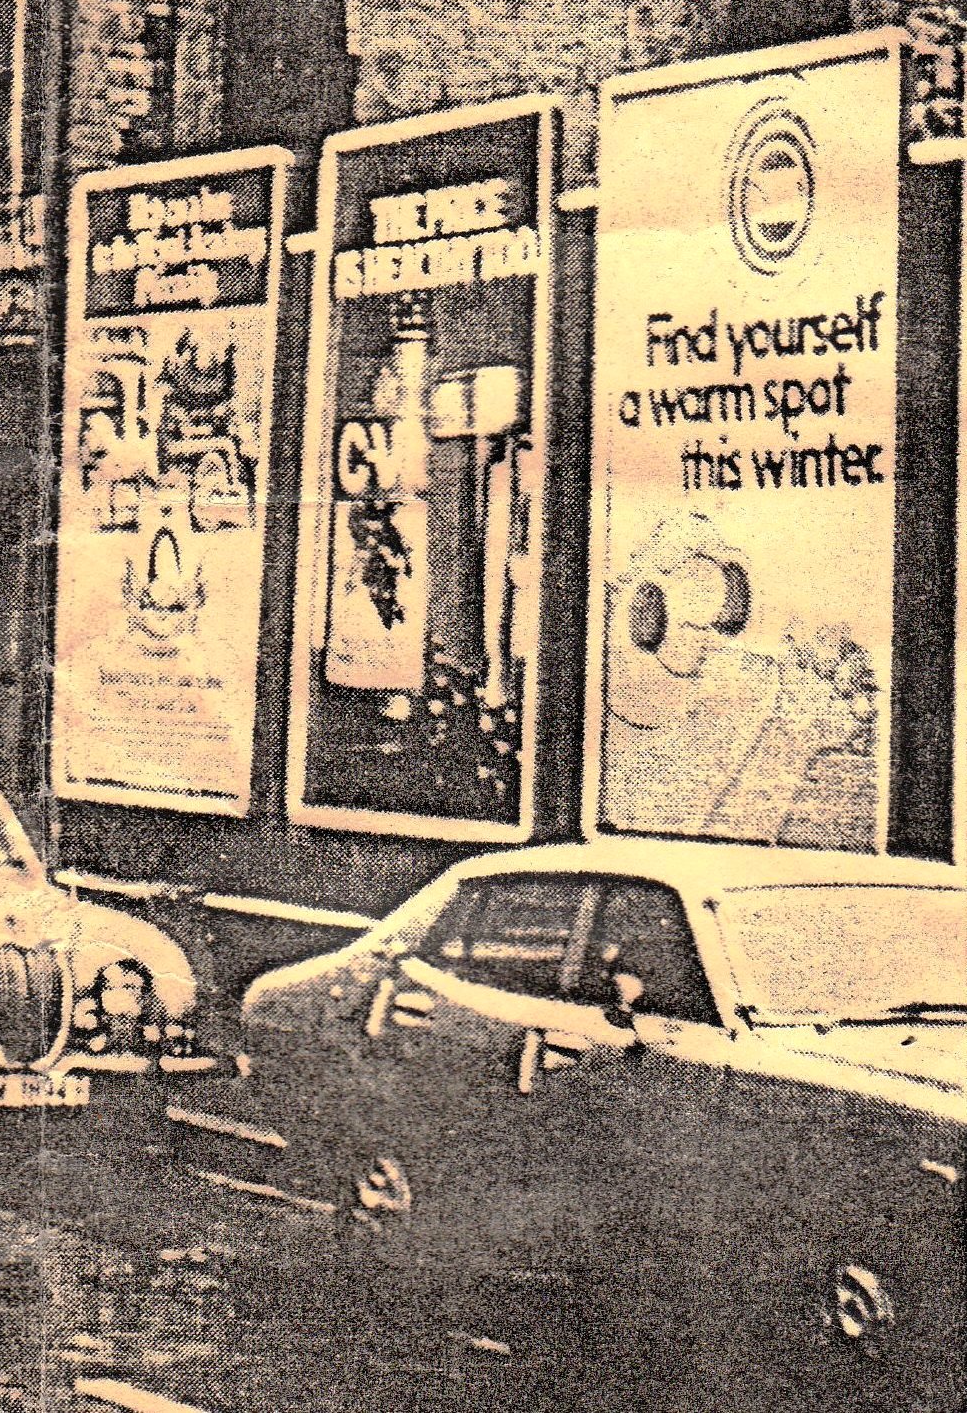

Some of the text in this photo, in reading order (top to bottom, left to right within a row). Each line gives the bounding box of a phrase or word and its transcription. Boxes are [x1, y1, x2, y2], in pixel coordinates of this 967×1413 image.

[646, 290, 886, 376] Find yourself
[618, 362, 852, 434] a warm spot
[680, 434, 742, 491] this
